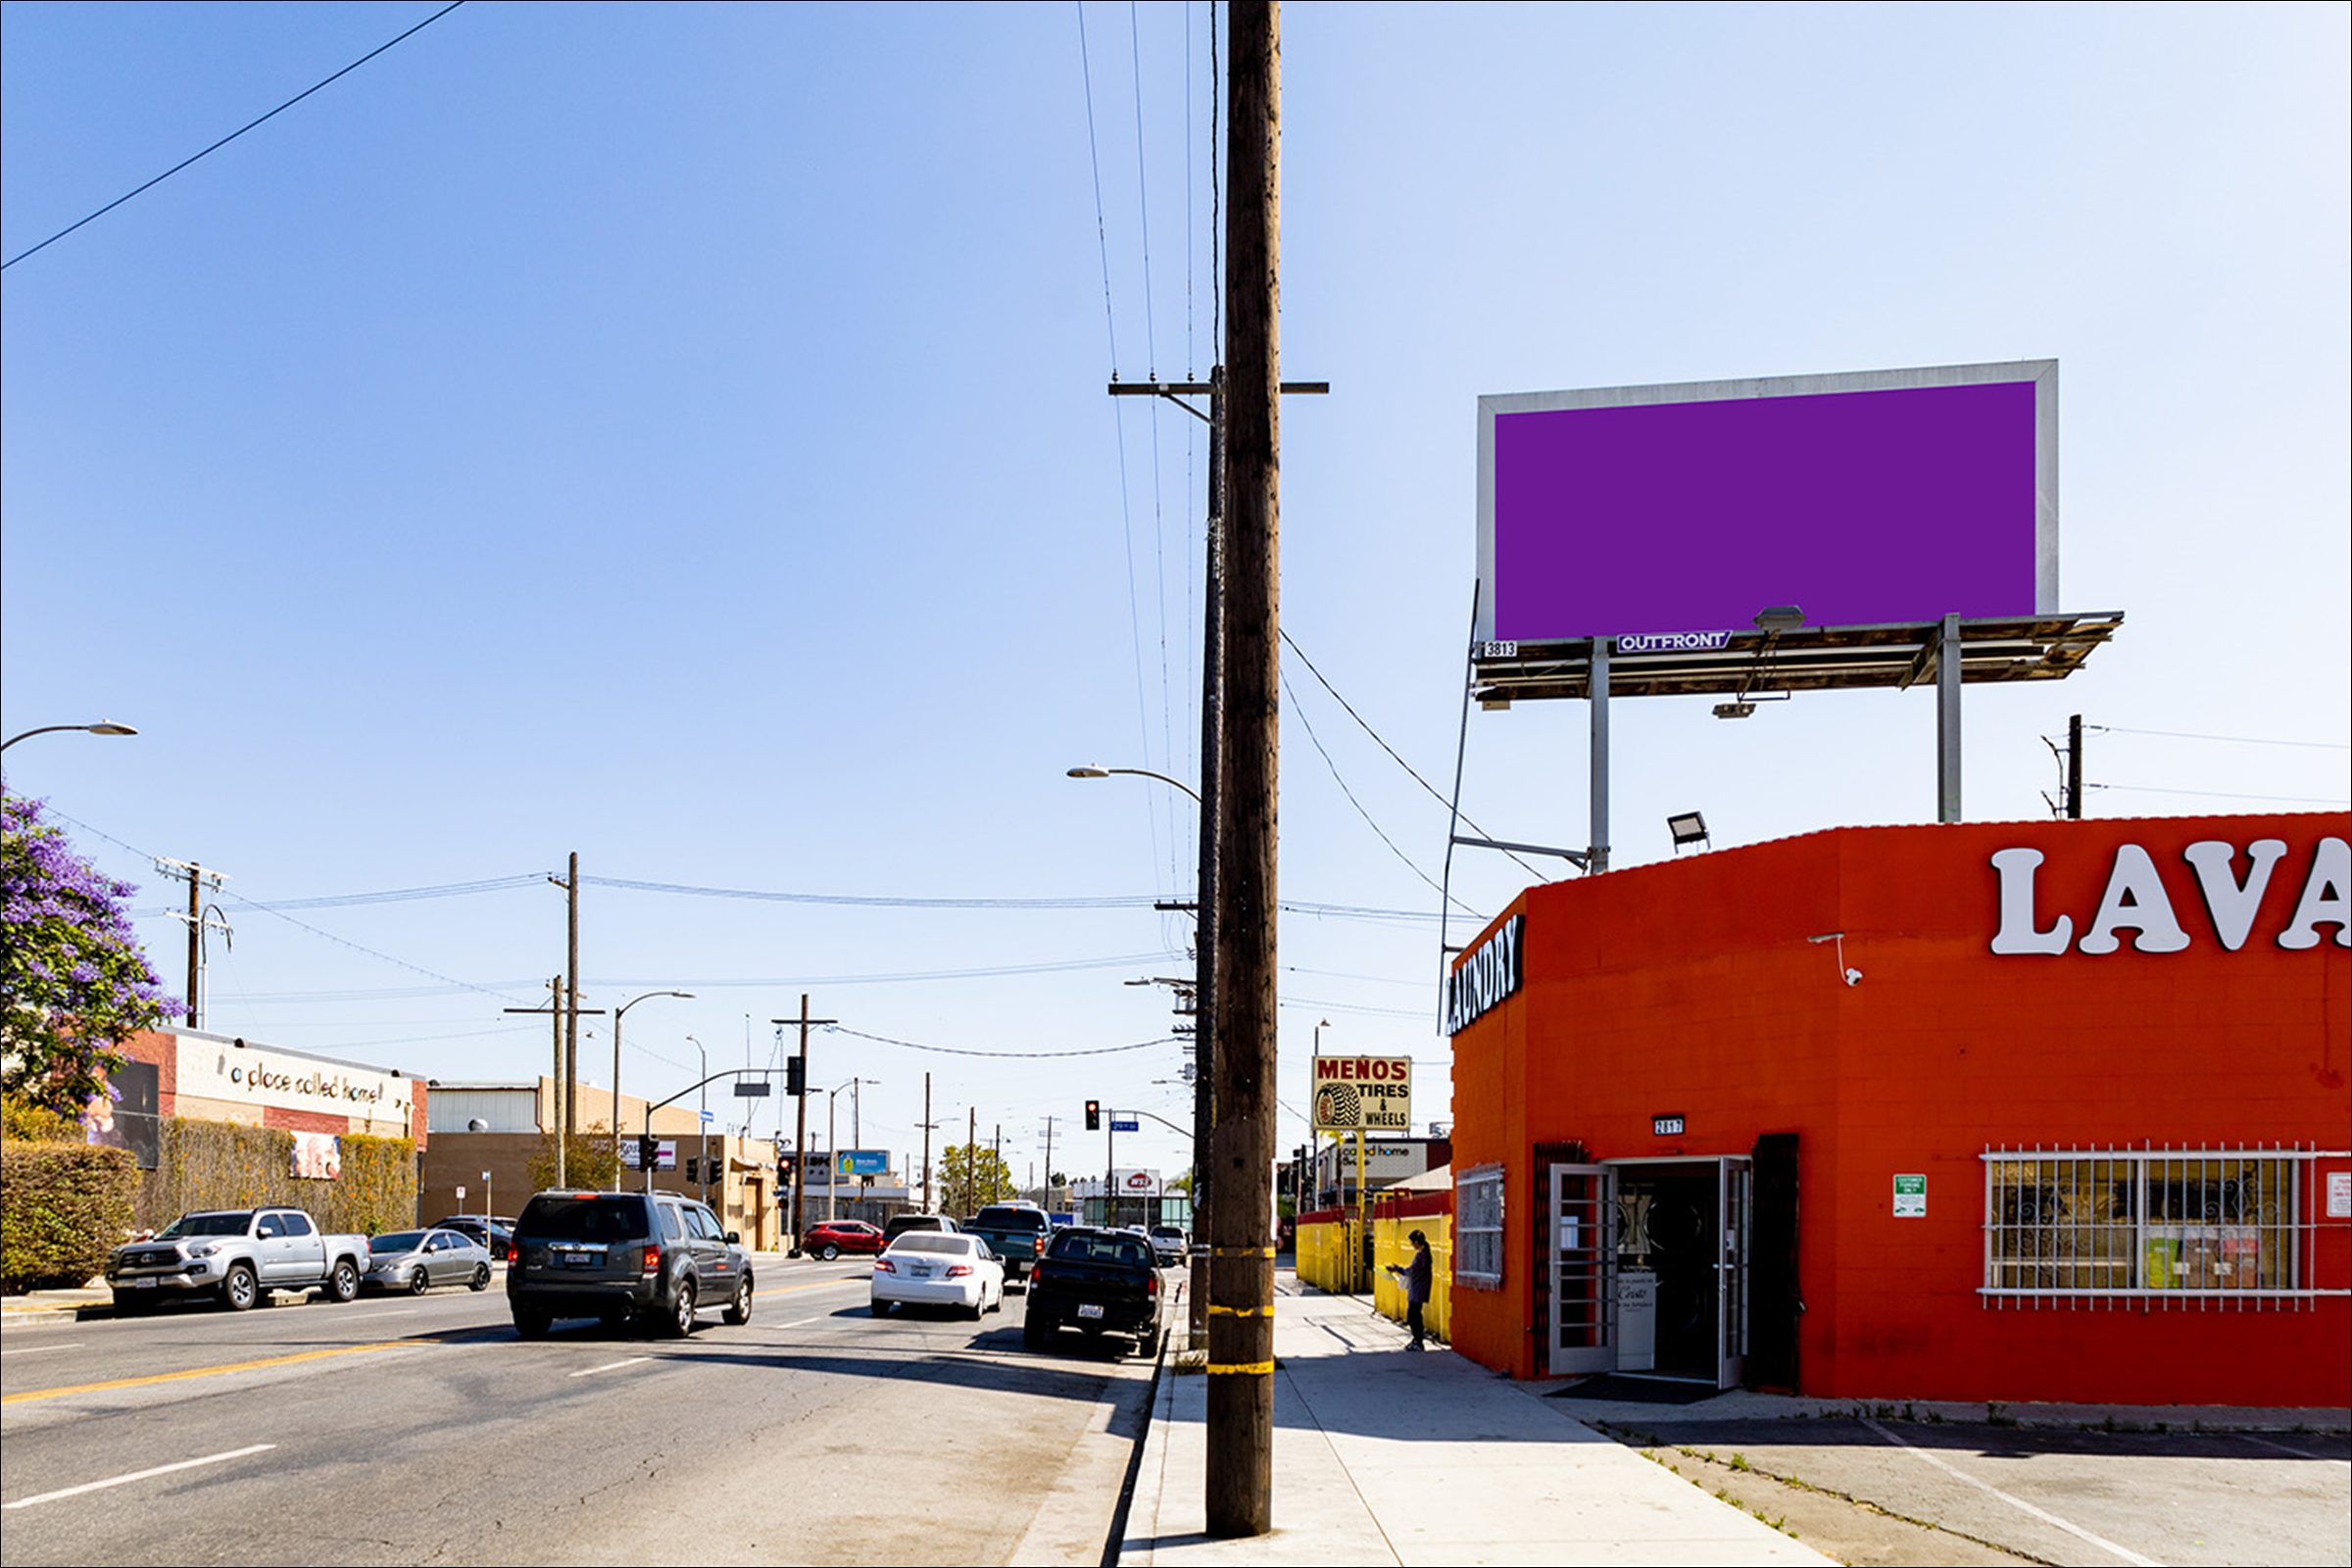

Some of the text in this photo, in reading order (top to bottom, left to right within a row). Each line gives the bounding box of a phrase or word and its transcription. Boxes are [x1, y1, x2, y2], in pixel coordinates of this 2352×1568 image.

[1621, 633, 1725, 650] OUTFRONT
[1487, 642, 1515, 657] 3813
[1990, 837, 2351, 956] LAVA
[1446, 914, 1525, 1038] LAUNDRY
[1317, 1059, 1407, 1081] MENOS
[230, 1066, 242, 1084] a
[248, 1061, 291, 1092] place
[295, 1071, 339, 1099] called
[1356, 1084, 1408, 1098] TIRES
[1379, 1099, 1387, 1111] &
[1365, 1112, 1406, 1126] WHEELS
[1657, 1120, 1682, 1133] 2817
[1343, 1145, 1409, 1156] caed home
[1994, 1166, 2035, 1177] OPEN
